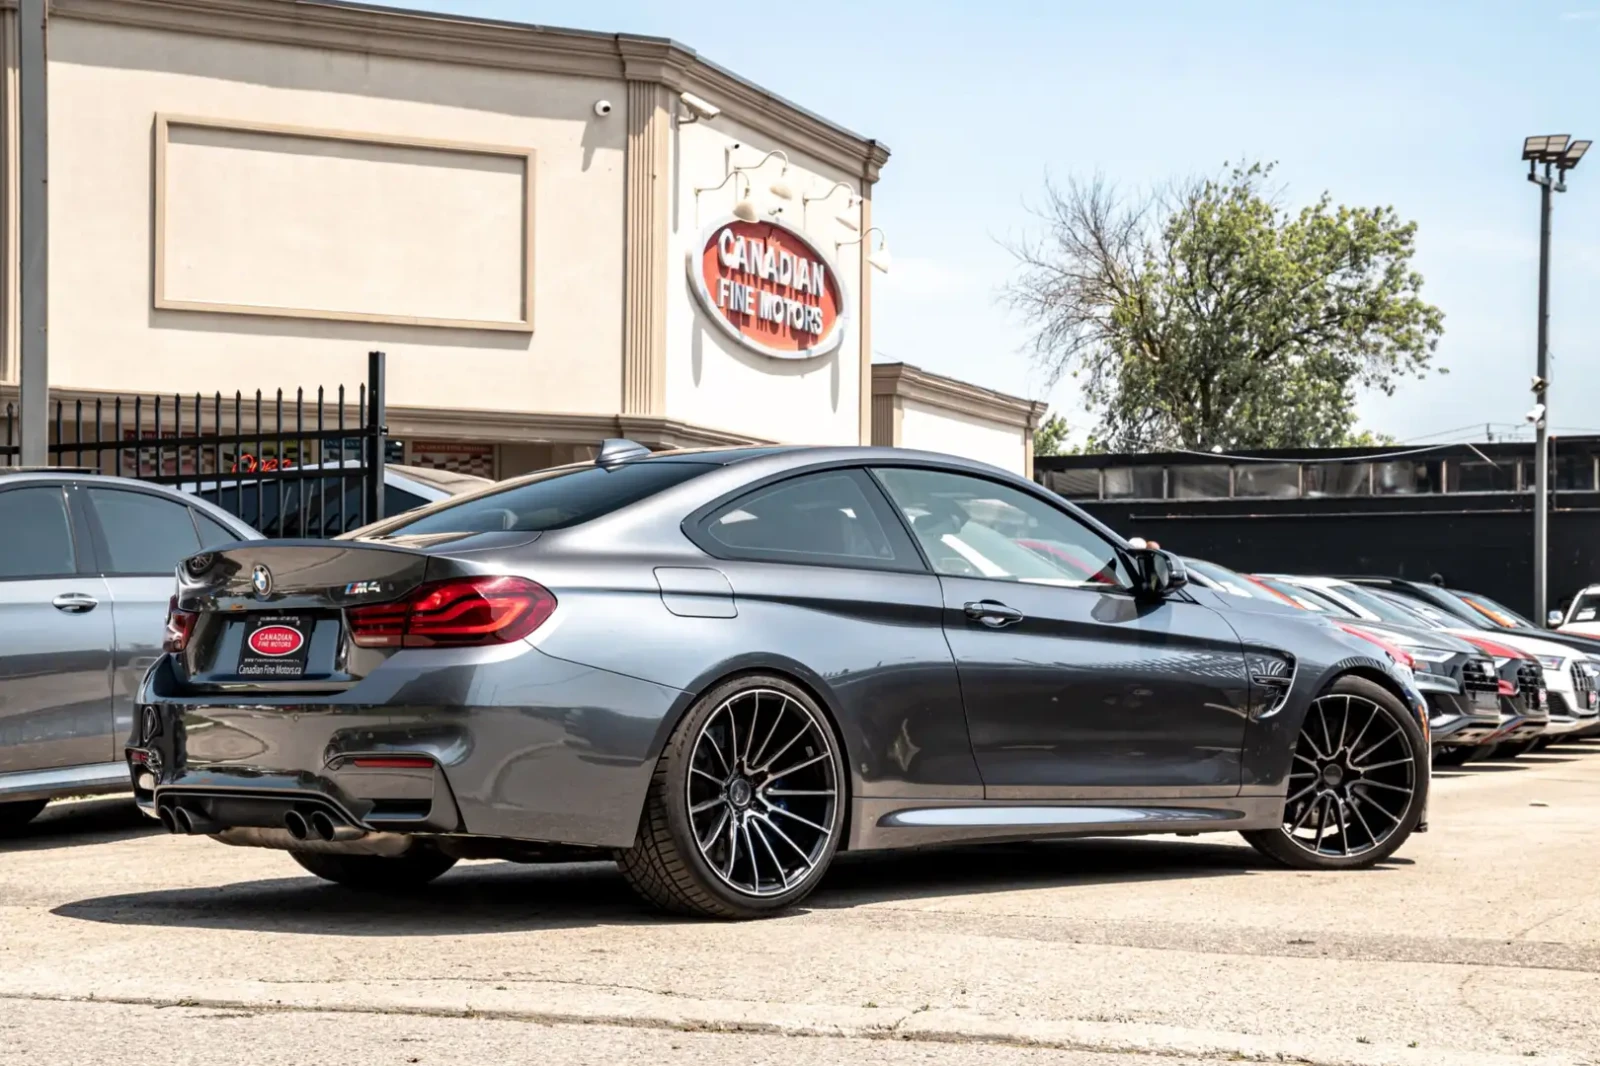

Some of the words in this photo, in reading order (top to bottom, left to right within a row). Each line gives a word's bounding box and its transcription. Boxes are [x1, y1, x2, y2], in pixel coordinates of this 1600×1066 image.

[718, 228, 824, 297] CANADIAN
[717, 278, 755, 316] FINE
[757, 290, 823, 335] MOTORS
[345, 581, 381, 594] M4
[259, 633, 293, 641] CANADIAN
[239, 664, 263, 675] Canadian
[264, 664, 275, 674] Fine
